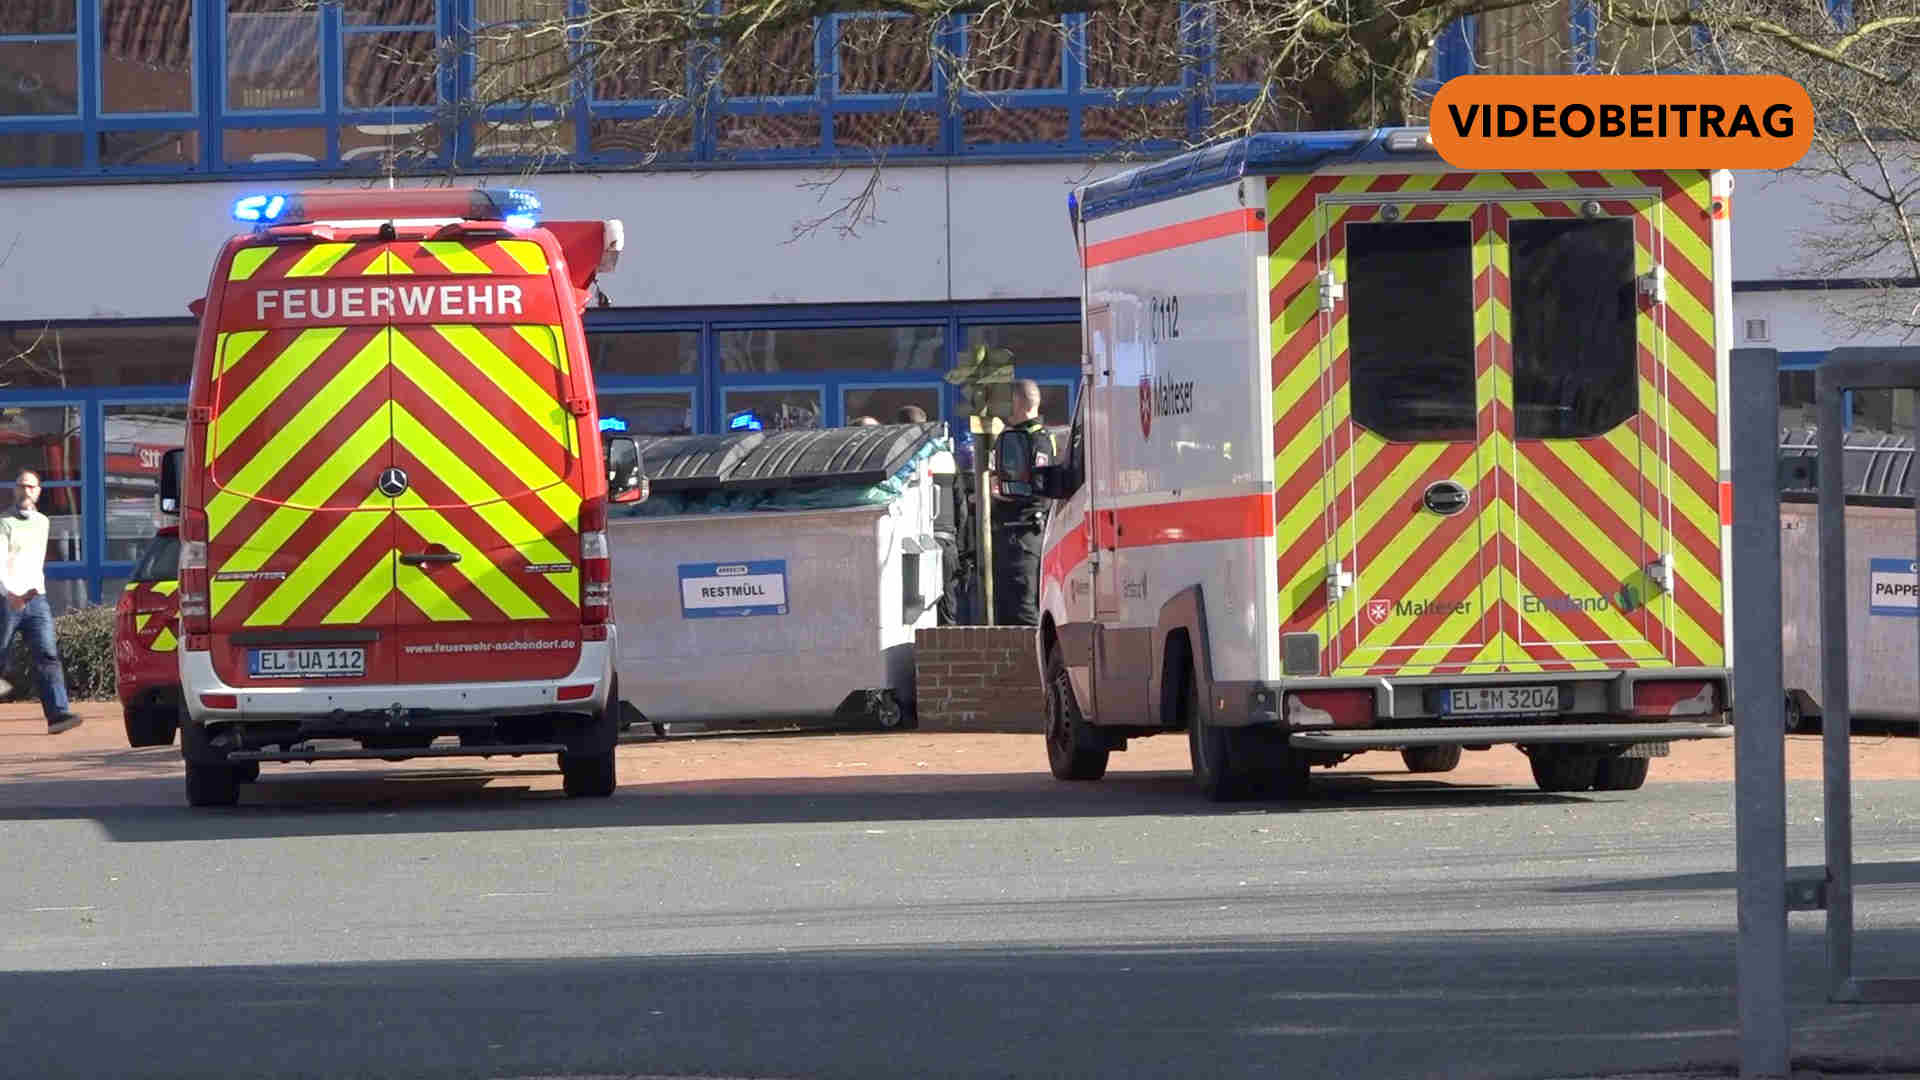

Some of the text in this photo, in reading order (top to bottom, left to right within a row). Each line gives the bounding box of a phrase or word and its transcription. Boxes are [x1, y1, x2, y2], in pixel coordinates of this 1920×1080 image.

[256, 284, 523, 320] FEUERWEHR
[1160, 296, 1179, 338] 112
[1154, 372, 1194, 416] Malteser
[702, 583, 766, 598] RESTMÜLL
[1396, 599, 1472, 616] Malteser
[261, 651, 362, 670] EL UA 112
[1452, 689, 1556, 710] EL M 3204
